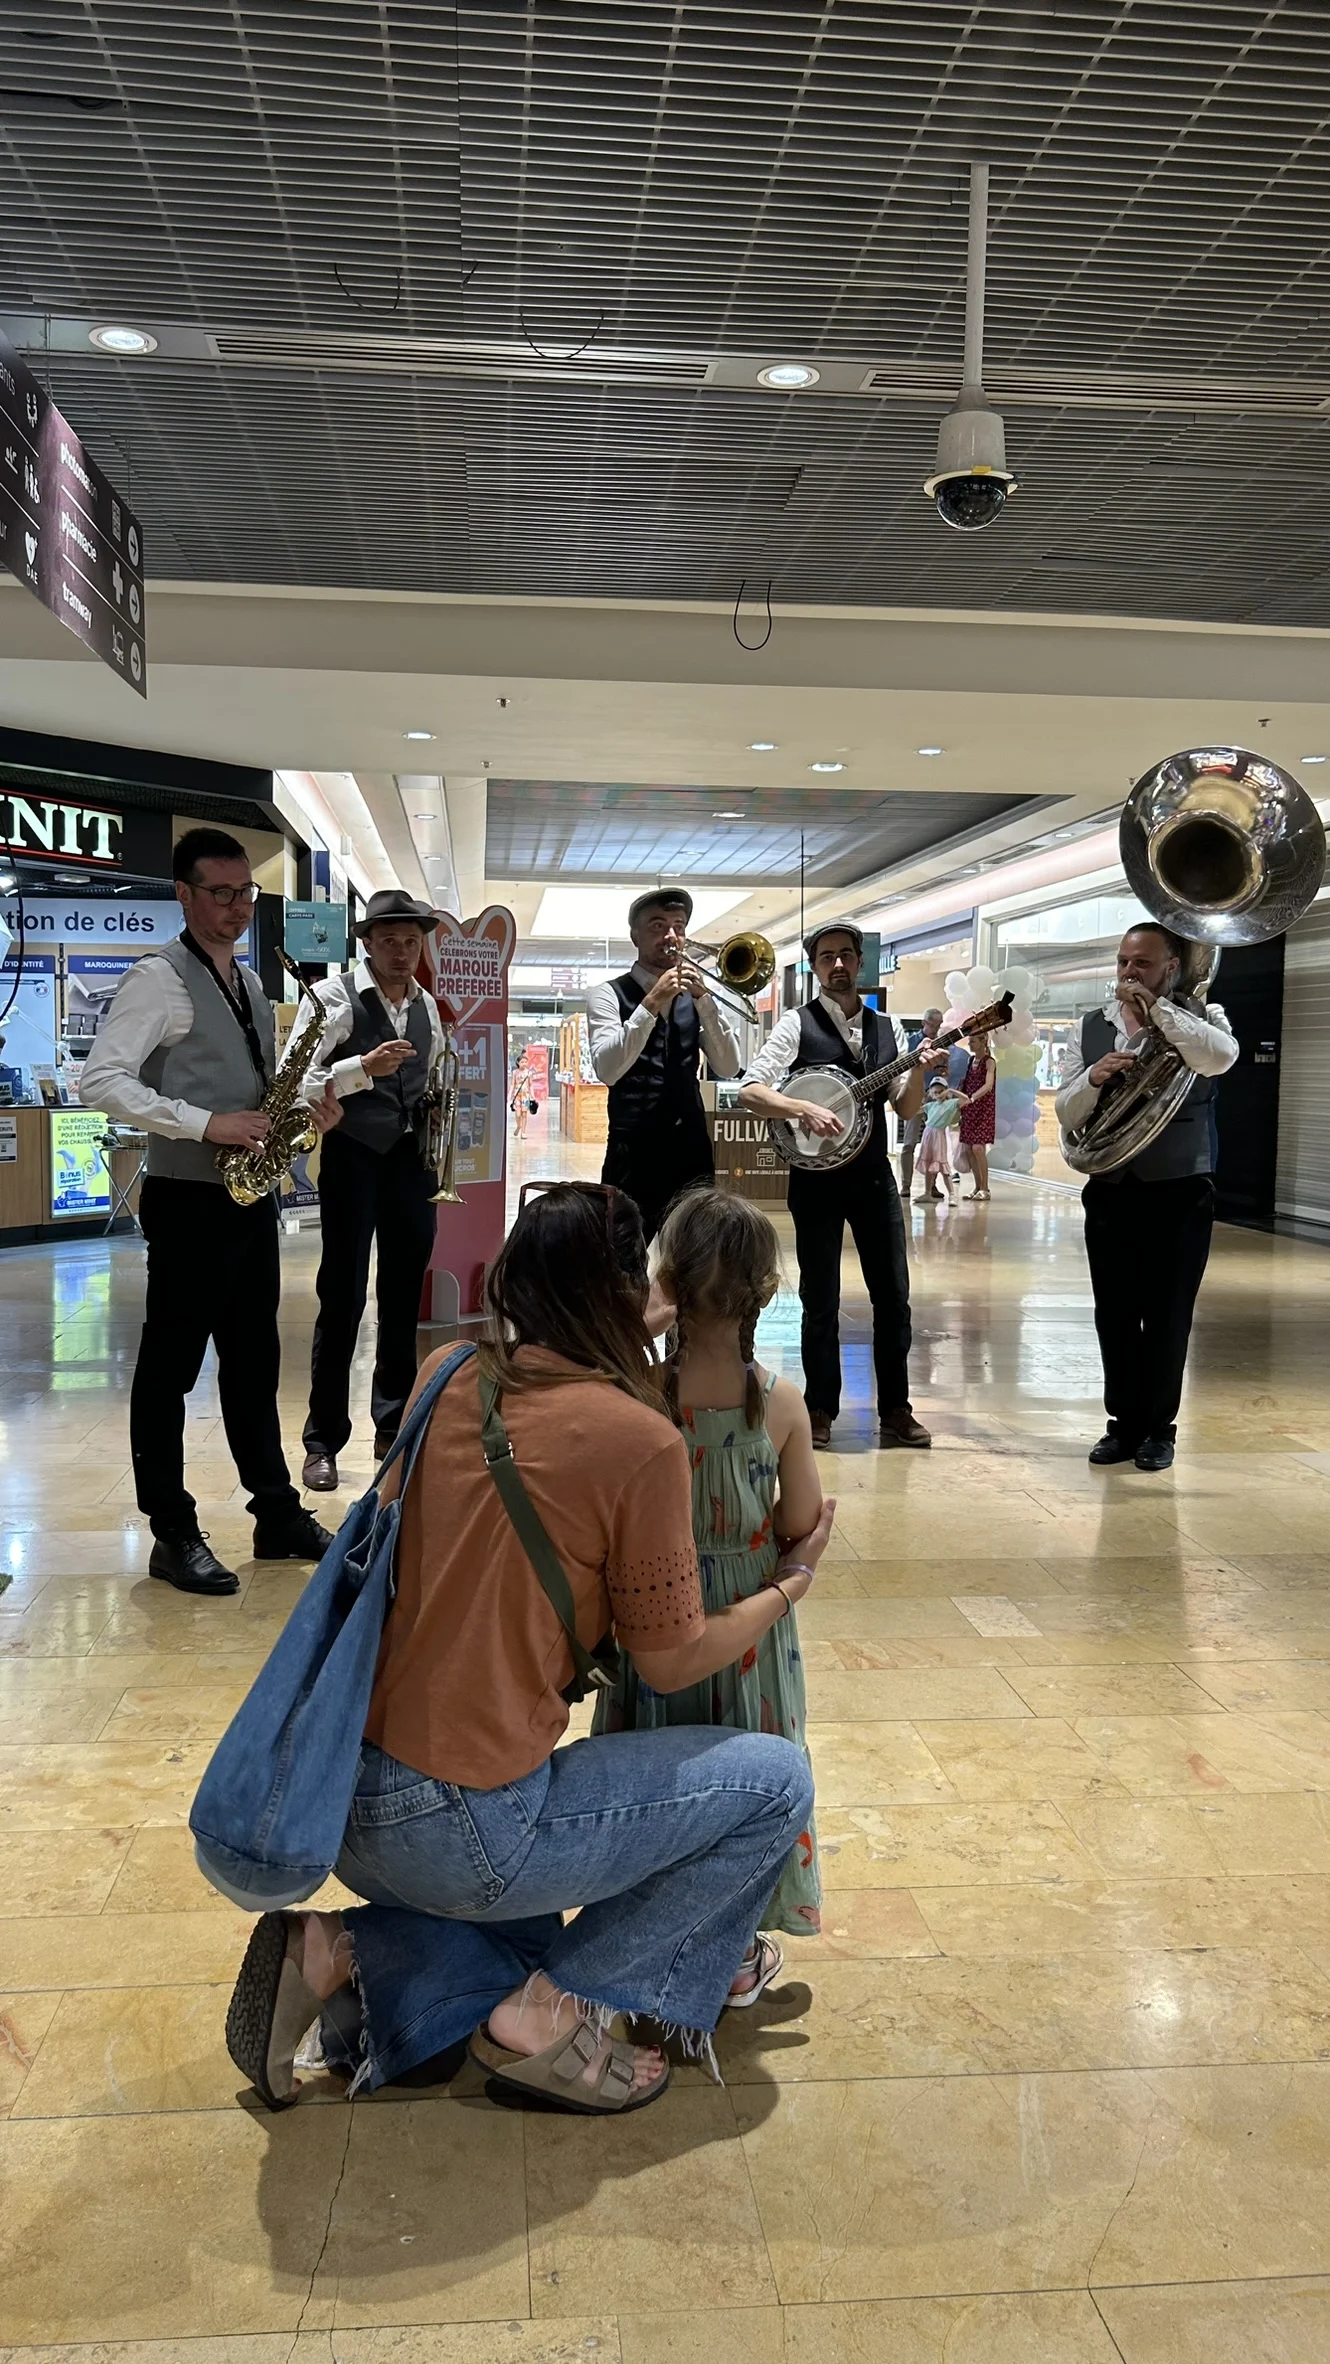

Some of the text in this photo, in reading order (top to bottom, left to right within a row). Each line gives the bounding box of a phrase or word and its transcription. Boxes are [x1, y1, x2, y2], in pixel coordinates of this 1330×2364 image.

[60, 442, 98, 502] photomaton
[60, 511, 97, 563] pharmacie
[26, 563, 38, 585] DAE
[62, 581, 92, 628] tramway
[0, 795, 123, 860] NIT
[64, 911, 95, 932] de
[104, 912, 155, 932] clés
[443, 936, 497, 949] Cette semaine
[478, 951, 498, 959] VOTRE
[440, 958, 498, 977] MARQUE
[437, 977, 501, 996] PRÉFÉRÉE
[296, 1193, 313, 1202] MISTER
